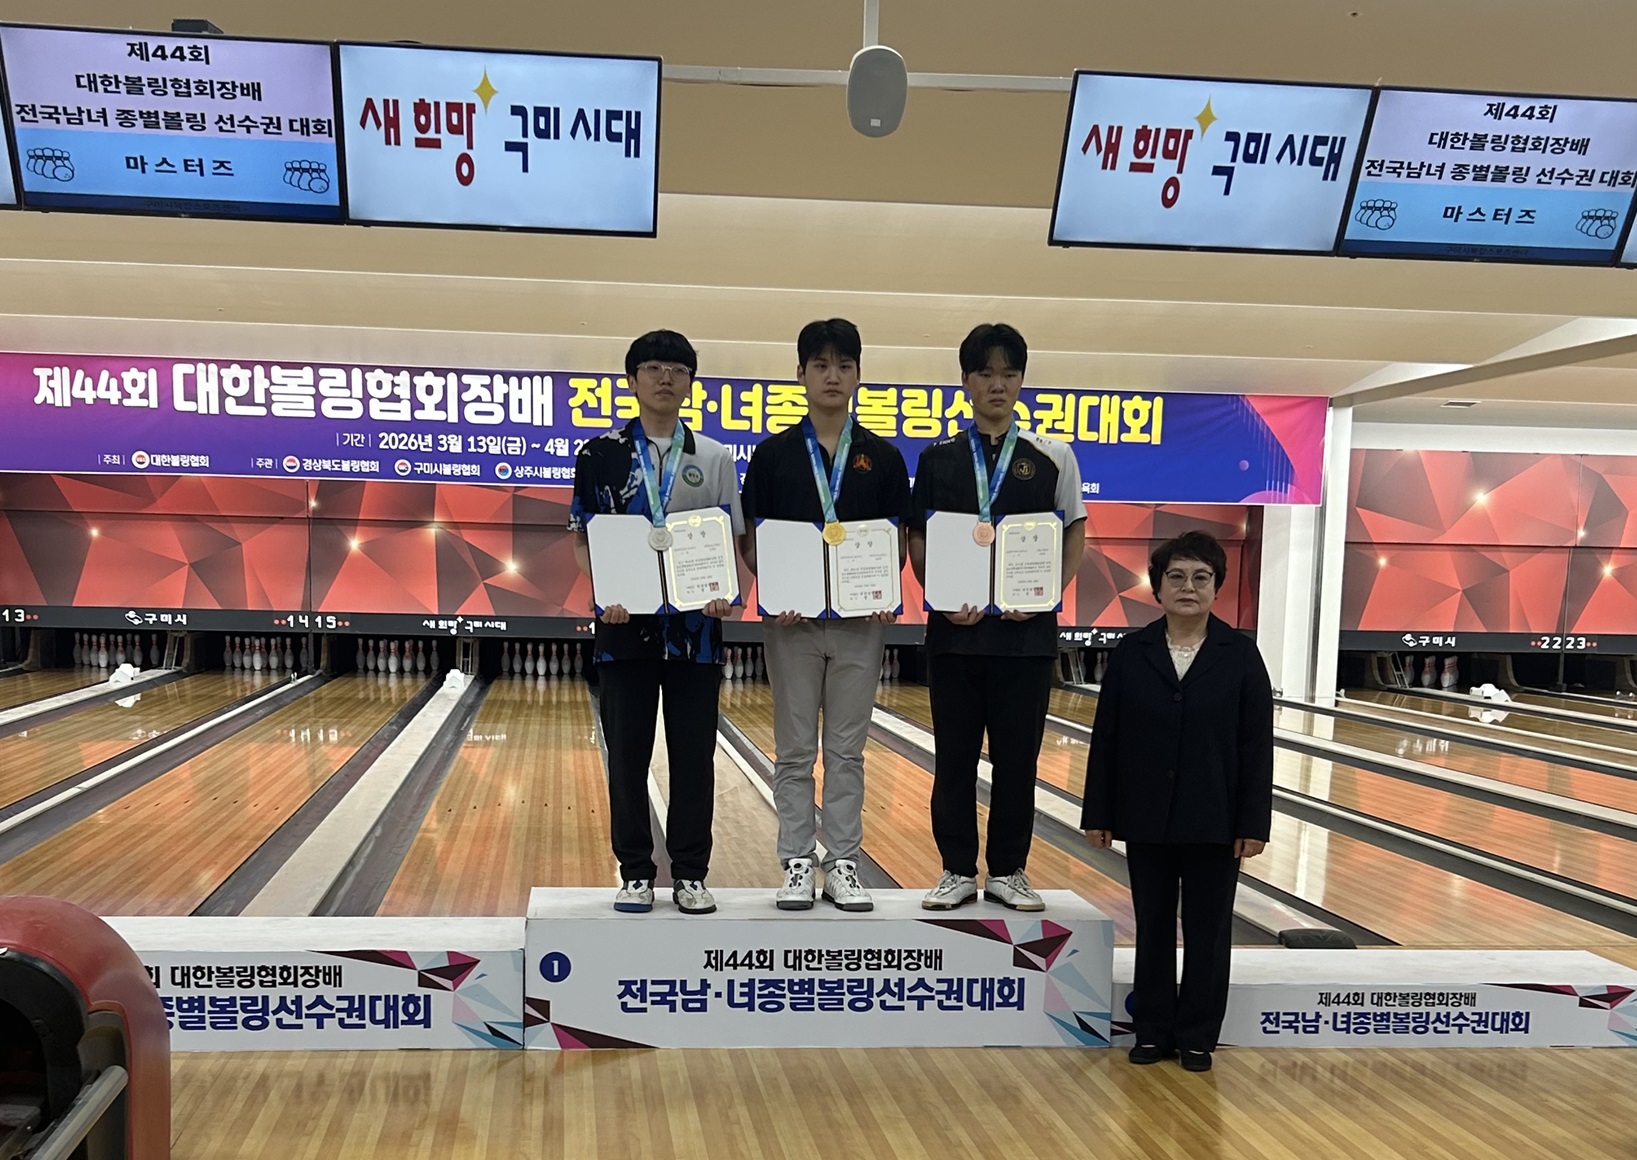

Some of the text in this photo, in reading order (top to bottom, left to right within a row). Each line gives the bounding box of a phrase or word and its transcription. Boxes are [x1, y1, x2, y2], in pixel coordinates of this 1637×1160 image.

[126, 41, 211, 66] 제44회
[75, 73, 263, 102] 대한볼링협회장배
[15, 103, 334, 139] 전국남녀 종별볼링 선수권 대회
[1483, 101, 1558, 124] 제44회
[1427, 131, 1591, 156] 대한볼링협회장배
[125, 155, 235, 178] 마스터즈
[1364, 159, 1637, 190] 전국남녀 종별볼링 선수권 대회
[1442, 205, 1537, 226] 마스터즈
[33, 366, 159, 409] 제44회
[172, 362, 554, 427] 대한볼링협회장배
[342, 433, 366, 447] 기간
[378, 432, 433, 452] 2026년
[437, 434, 463, 453] 3월
[467, 435, 527, 456] 13일(금)
[544, 438, 570, 457] 4월
[573, 439, 590, 456] 2
[103, 454, 120, 465] 주최
[150, 454, 210, 468] 대한볼링협회
[256, 458, 273, 469] 주관
[302, 458, 380, 473] 경상북도볼링협회
[413, 462, 481, 476] 구미시볼링협회
[2, 609, 25, 623] 13
[144, 613, 188, 625] 구미시
[286, 615, 338, 629] 14 15
[588, 623, 596, 634] 1
[1418, 636, 1457, 647] 구미시
[1540, 636, 1586, 649] 22 23
[550, 958, 561, 976] 1
[702, 948, 943, 973] 제44회 대한볼링협회장배
[170, 964, 343, 989] 대한볼링협회장배
[615, 976, 1026, 1013] 전국남·녀종별볼링선수권대회
[1317, 991, 1477, 1009] 제44회 대한볼링협회장배
[1260, 1011, 1531, 1035] 전국남·녀종별볼링선수권대회
